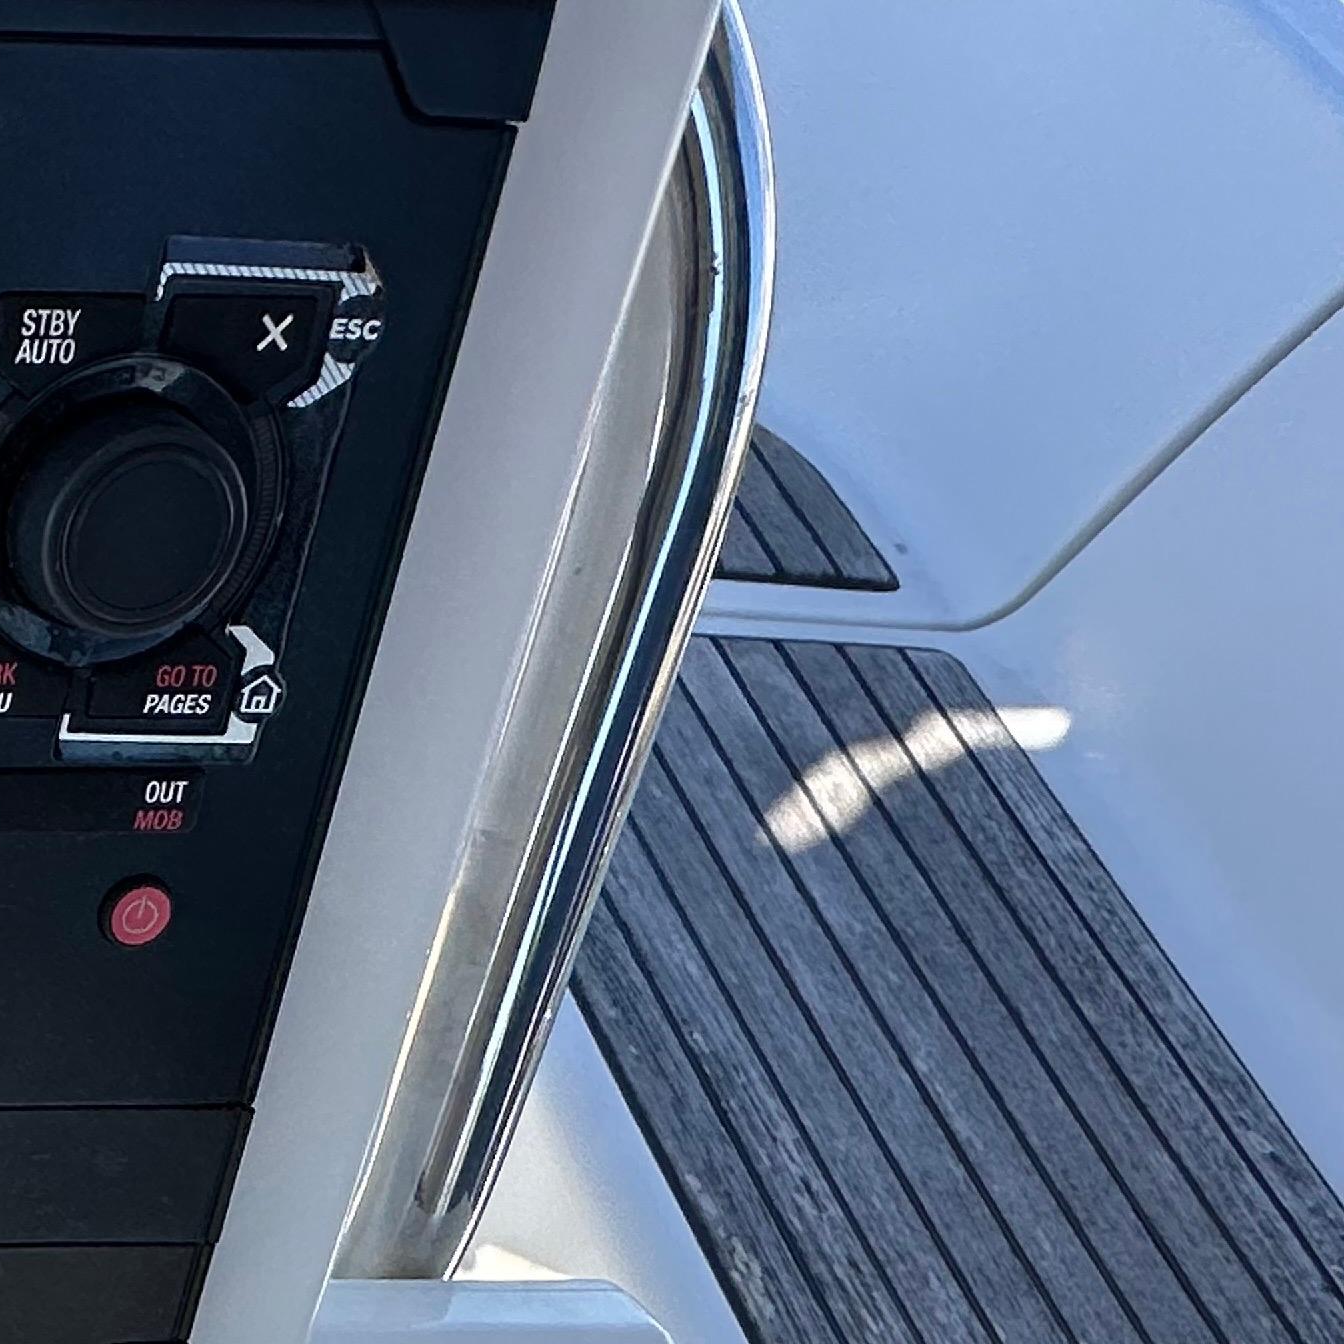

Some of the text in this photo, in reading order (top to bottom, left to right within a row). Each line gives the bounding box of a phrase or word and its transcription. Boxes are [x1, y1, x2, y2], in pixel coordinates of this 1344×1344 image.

[20, 308, 82, 337] STBY
[328, 317, 382, 341] ESC
[14, 339, 77, 365] AUTO
[156, 664, 218, 688] GO TO
[143, 694, 212, 715] PAGES
[144, 780, 188, 803] OUT
[133, 809, 184, 831] MOB
